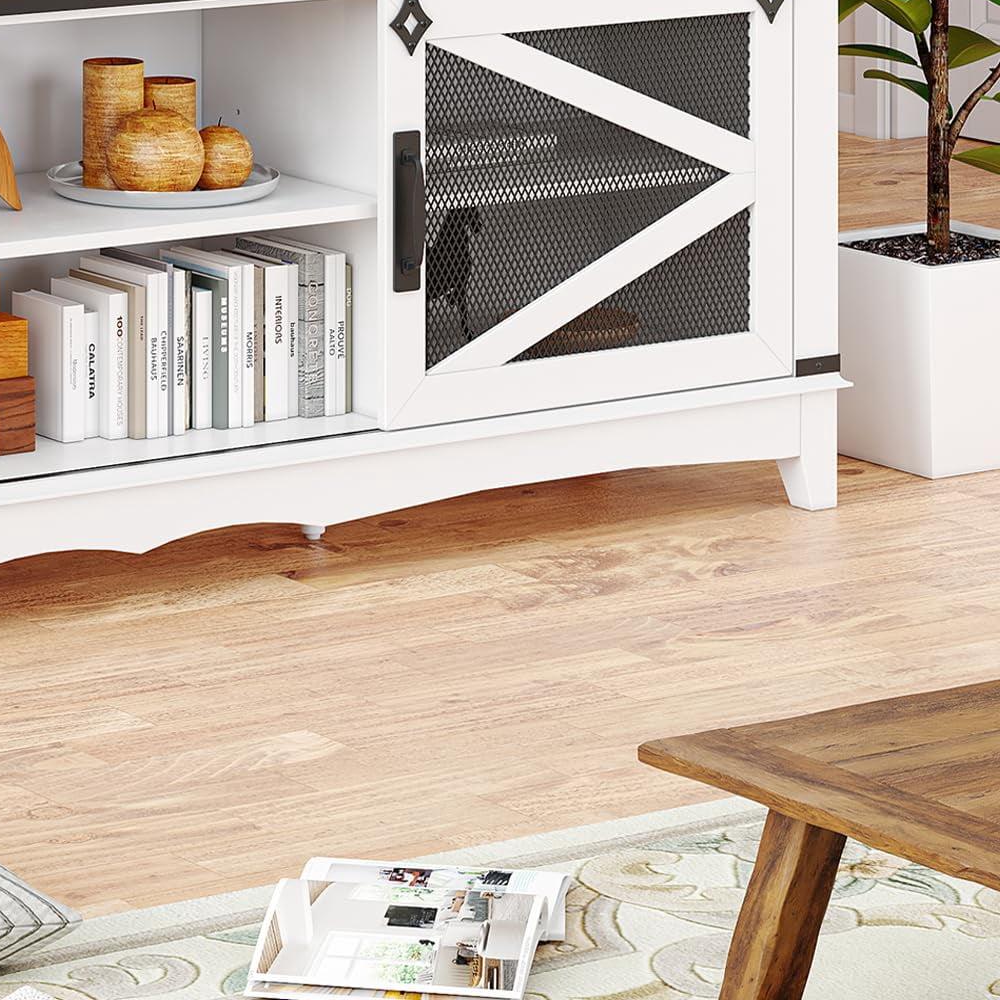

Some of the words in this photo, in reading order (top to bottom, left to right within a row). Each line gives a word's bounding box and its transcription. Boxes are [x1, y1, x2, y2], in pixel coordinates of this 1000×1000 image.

[220, 297, 228, 353] MUSEUMS
[328, 328, 336, 357] AALTO
[150, 337, 158, 381] BAUHAUS
[245, 331, 253, 369] MORRIS
[116, 397, 124, 426] HOUSES
